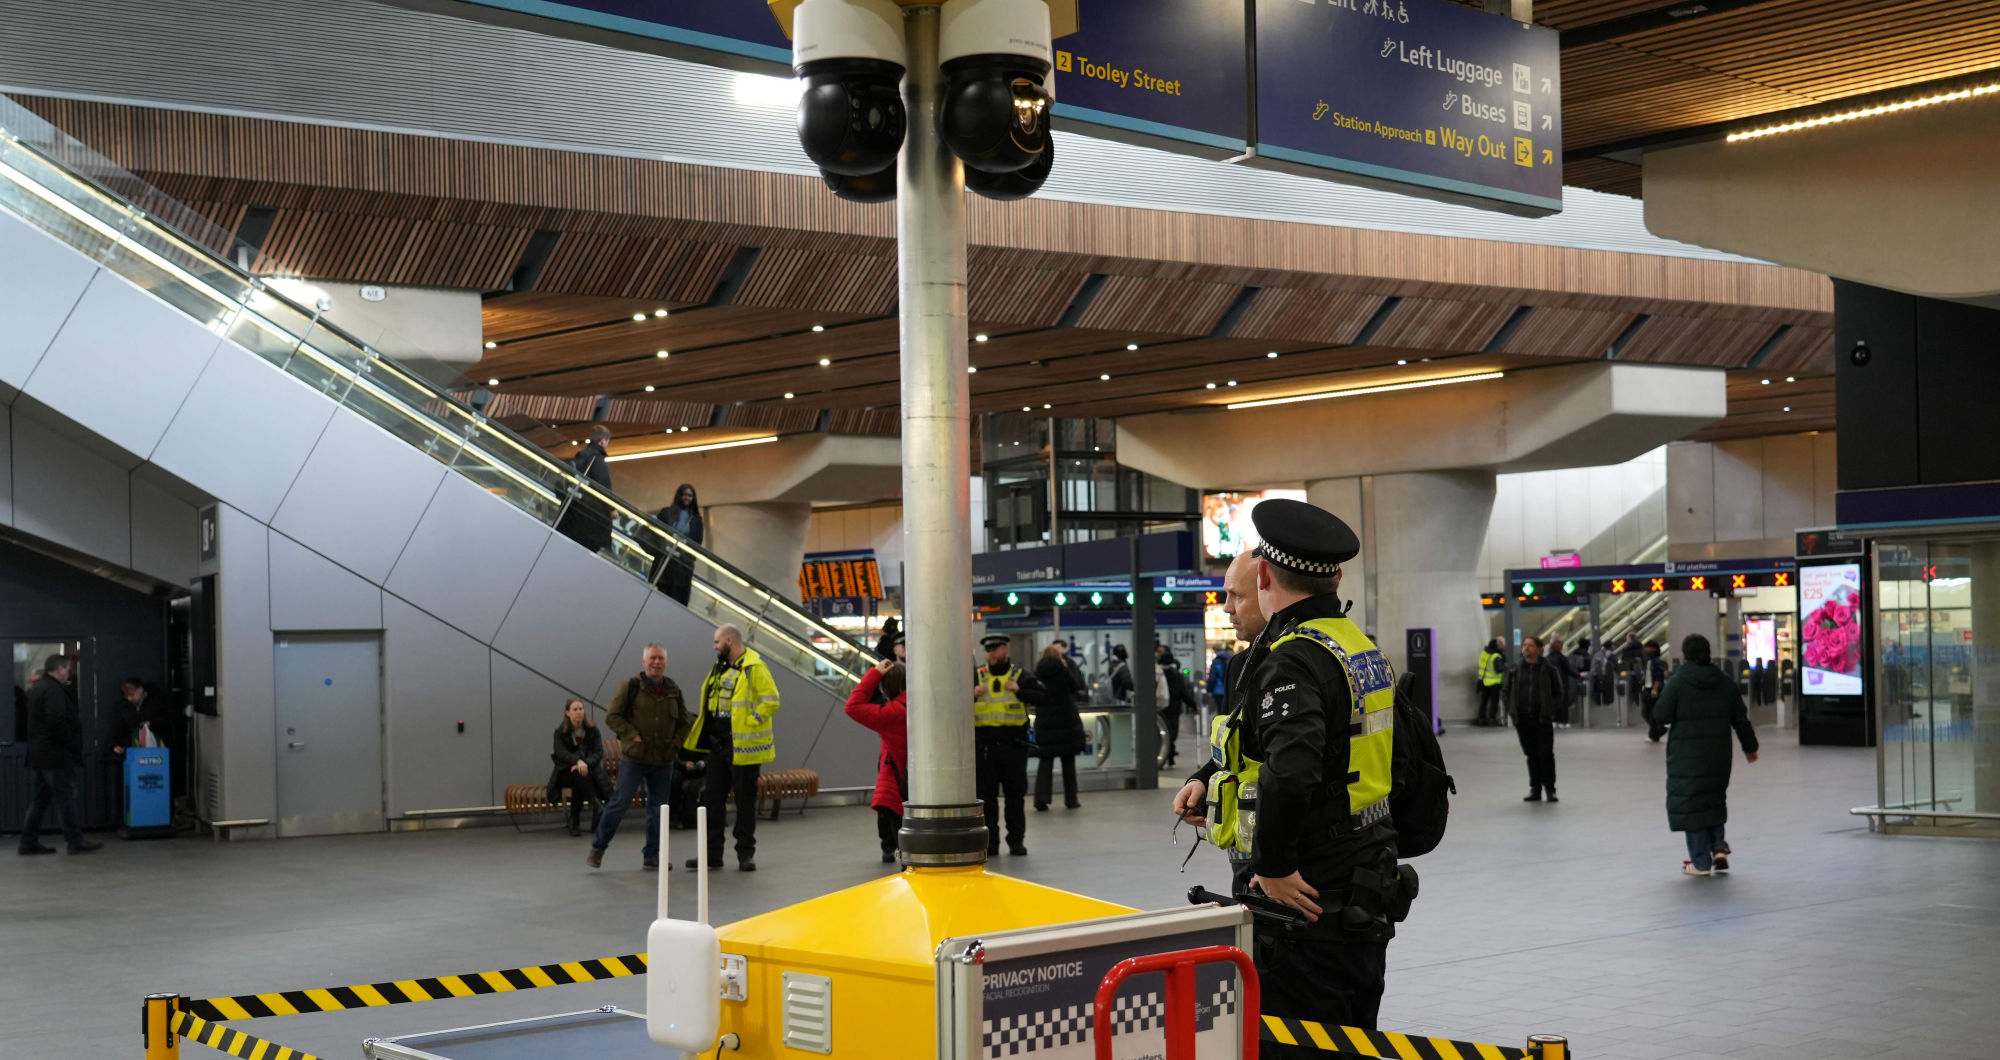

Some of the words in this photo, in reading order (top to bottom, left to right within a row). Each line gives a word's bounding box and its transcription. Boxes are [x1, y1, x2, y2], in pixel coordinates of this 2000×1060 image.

[1060, 55, 1068, 68] 2
[1077, 56, 1129, 88] Tooley
[1133, 69, 1181, 96] Street
[1400, 40, 1433, 69] Left
[1437, 49, 1502, 87] Luggage
[1461, 94, 1506, 123] Buses
[1333, 112, 1371, 133] Station
[1374, 120, 1422, 143] Approach
[1440, 126, 1474, 158] Way
[1478, 135, 1507, 160] Out
[1687, 562, 1718, 572] platforms
[1186, 578, 1212, 587] platforms
[1174, 631, 1196, 645] Lift
[1274, 683, 1296, 693] POLICE
[1355, 663, 1393, 690] POLICE
[983, 967, 1036, 990] PRIVACY
[1037, 961, 1083, 982] NOTICE
[1005, 983, 1050, 998] RECOGNITION
